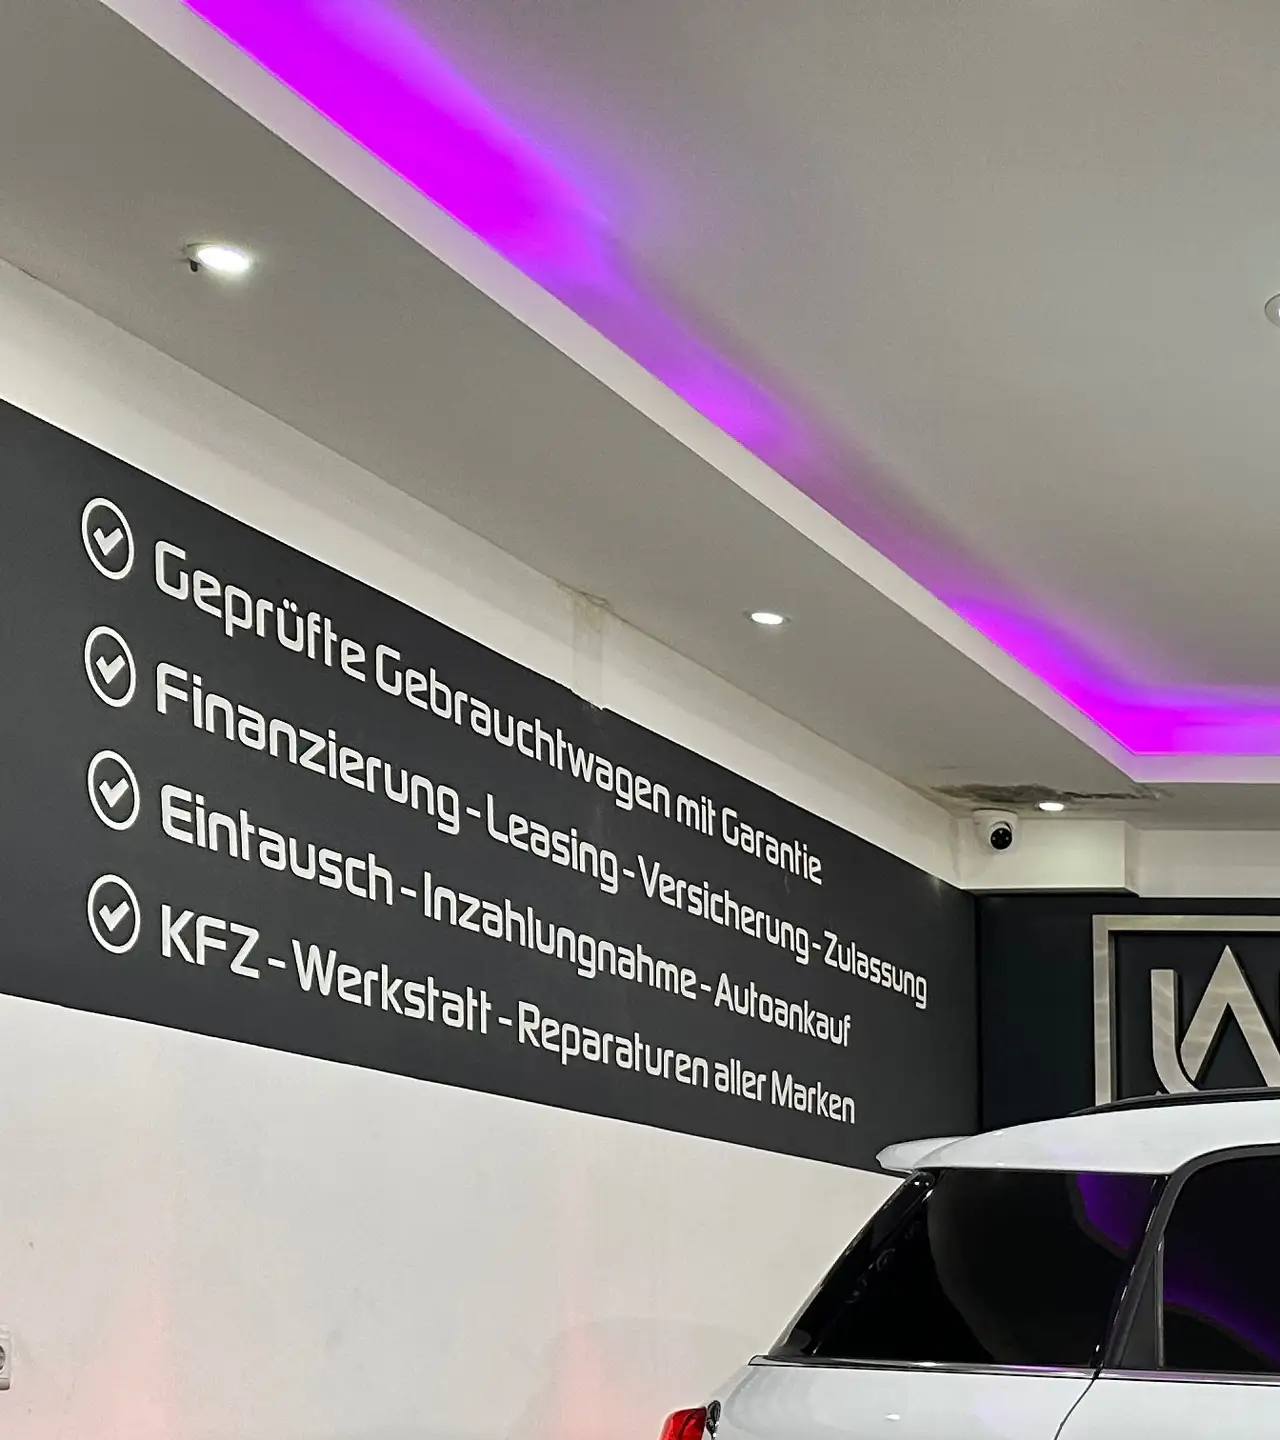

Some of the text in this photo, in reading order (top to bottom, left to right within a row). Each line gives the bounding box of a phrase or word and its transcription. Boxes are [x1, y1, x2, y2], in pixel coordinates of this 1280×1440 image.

[155, 540, 823, 886] Geprüfte Gebrauchtwagen mit Garantie
[714, 1058, 767, 1102] aller
[771, 1069, 855, 1125] Marken
